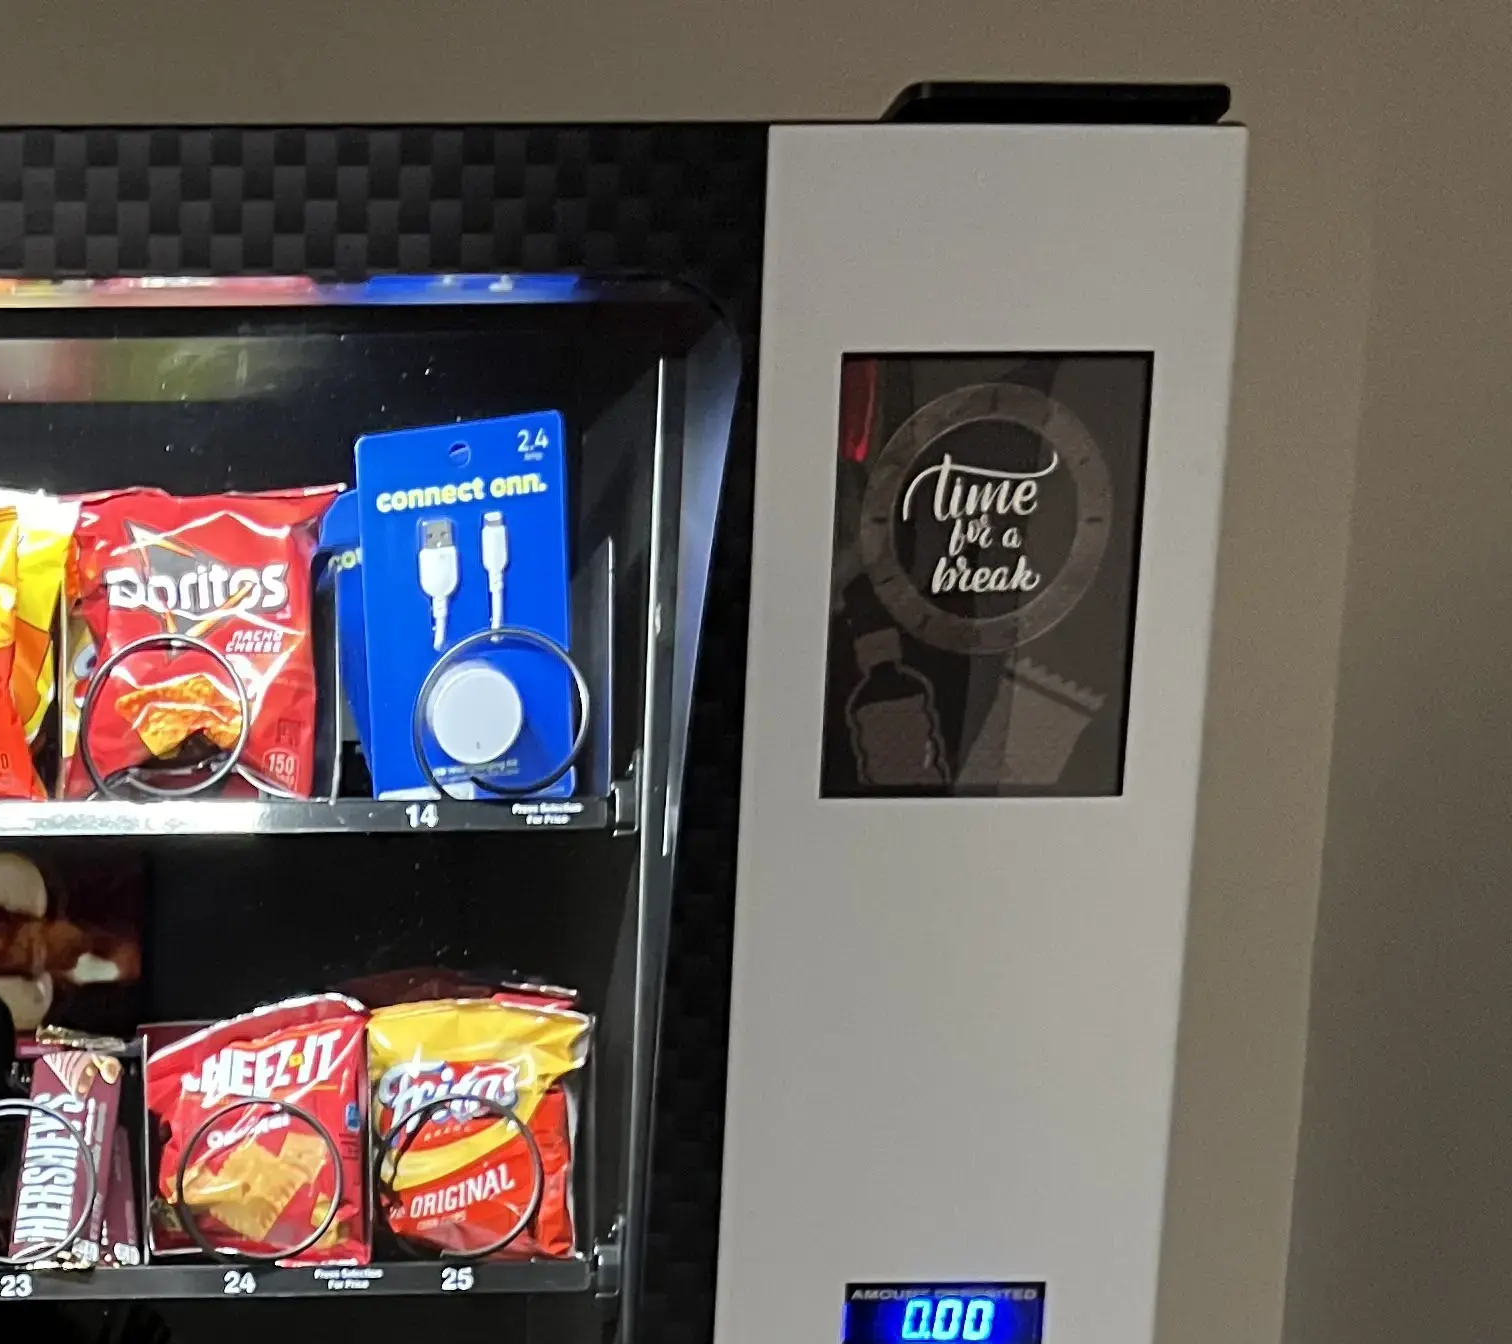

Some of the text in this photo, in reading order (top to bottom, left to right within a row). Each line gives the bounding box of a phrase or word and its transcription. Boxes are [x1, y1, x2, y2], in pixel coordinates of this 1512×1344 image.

[517, 429, 549, 453] 2.4
[376, 473, 548, 513] connect onn.
[948, 516, 1023, 557] for a
[105, 564, 288, 612] Doritos
[931, 555, 1042, 595] break
[269, 753, 294, 773] 150
[405, 803, 439, 828] 14
[14, 1092, 85, 1244] HERSHEY'S
[410, 1163, 516, 1218] ORIGINAL
[0, 1274, 33, 1298] 23
[223, 1271, 257, 1294] 24
[441, 1267, 474, 1291] 25
